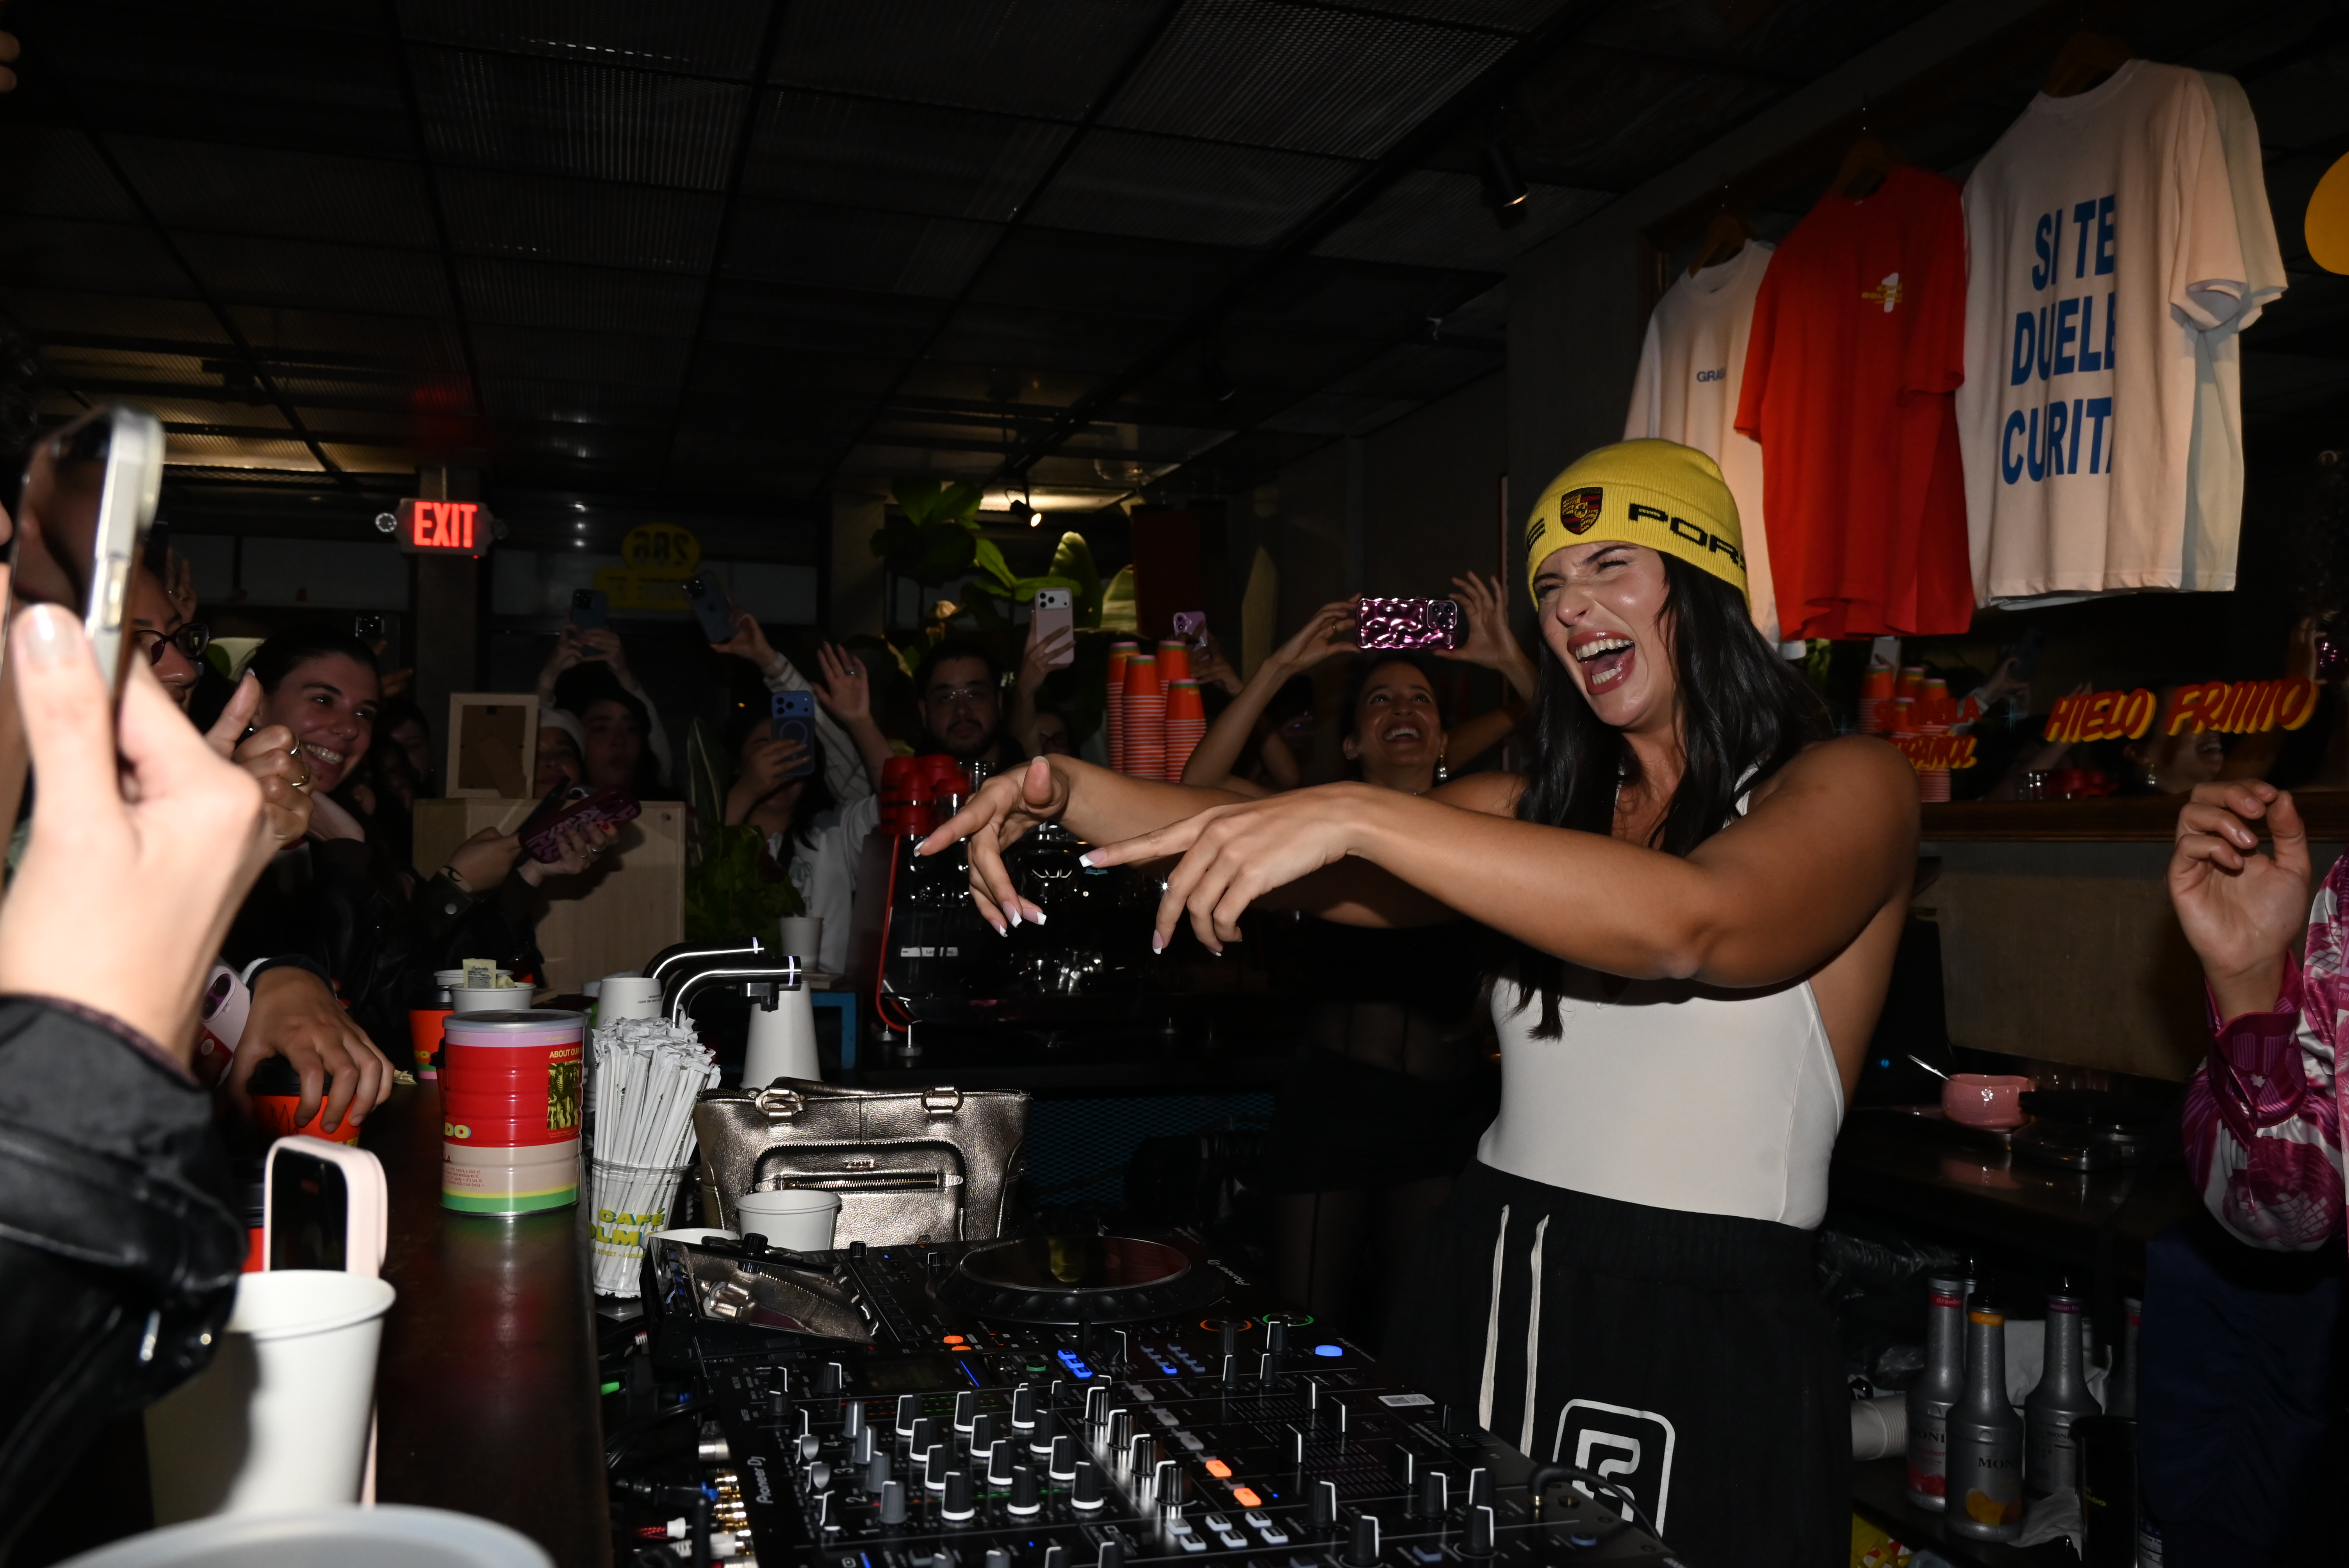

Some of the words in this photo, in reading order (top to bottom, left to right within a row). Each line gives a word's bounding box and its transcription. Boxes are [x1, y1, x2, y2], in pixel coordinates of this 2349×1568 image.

[2032, 209, 2062, 290] SI
[2074, 194, 2115, 278] TE
[2002, 397, 2112, 485] CURIT
[414, 502, 478, 547] EXIT
[2045, 688, 2157, 743] HIELO
[549, 1049, 570, 1058] ABOUT
[571, 1047, 580, 1056] OUR
[599, 1208, 665, 1226] CAFÉ
[1217, 1265, 1251, 1285] Pioneer
[747, 1456, 766, 1466] DJ
[754, 1467, 774, 1504] Pioneer
